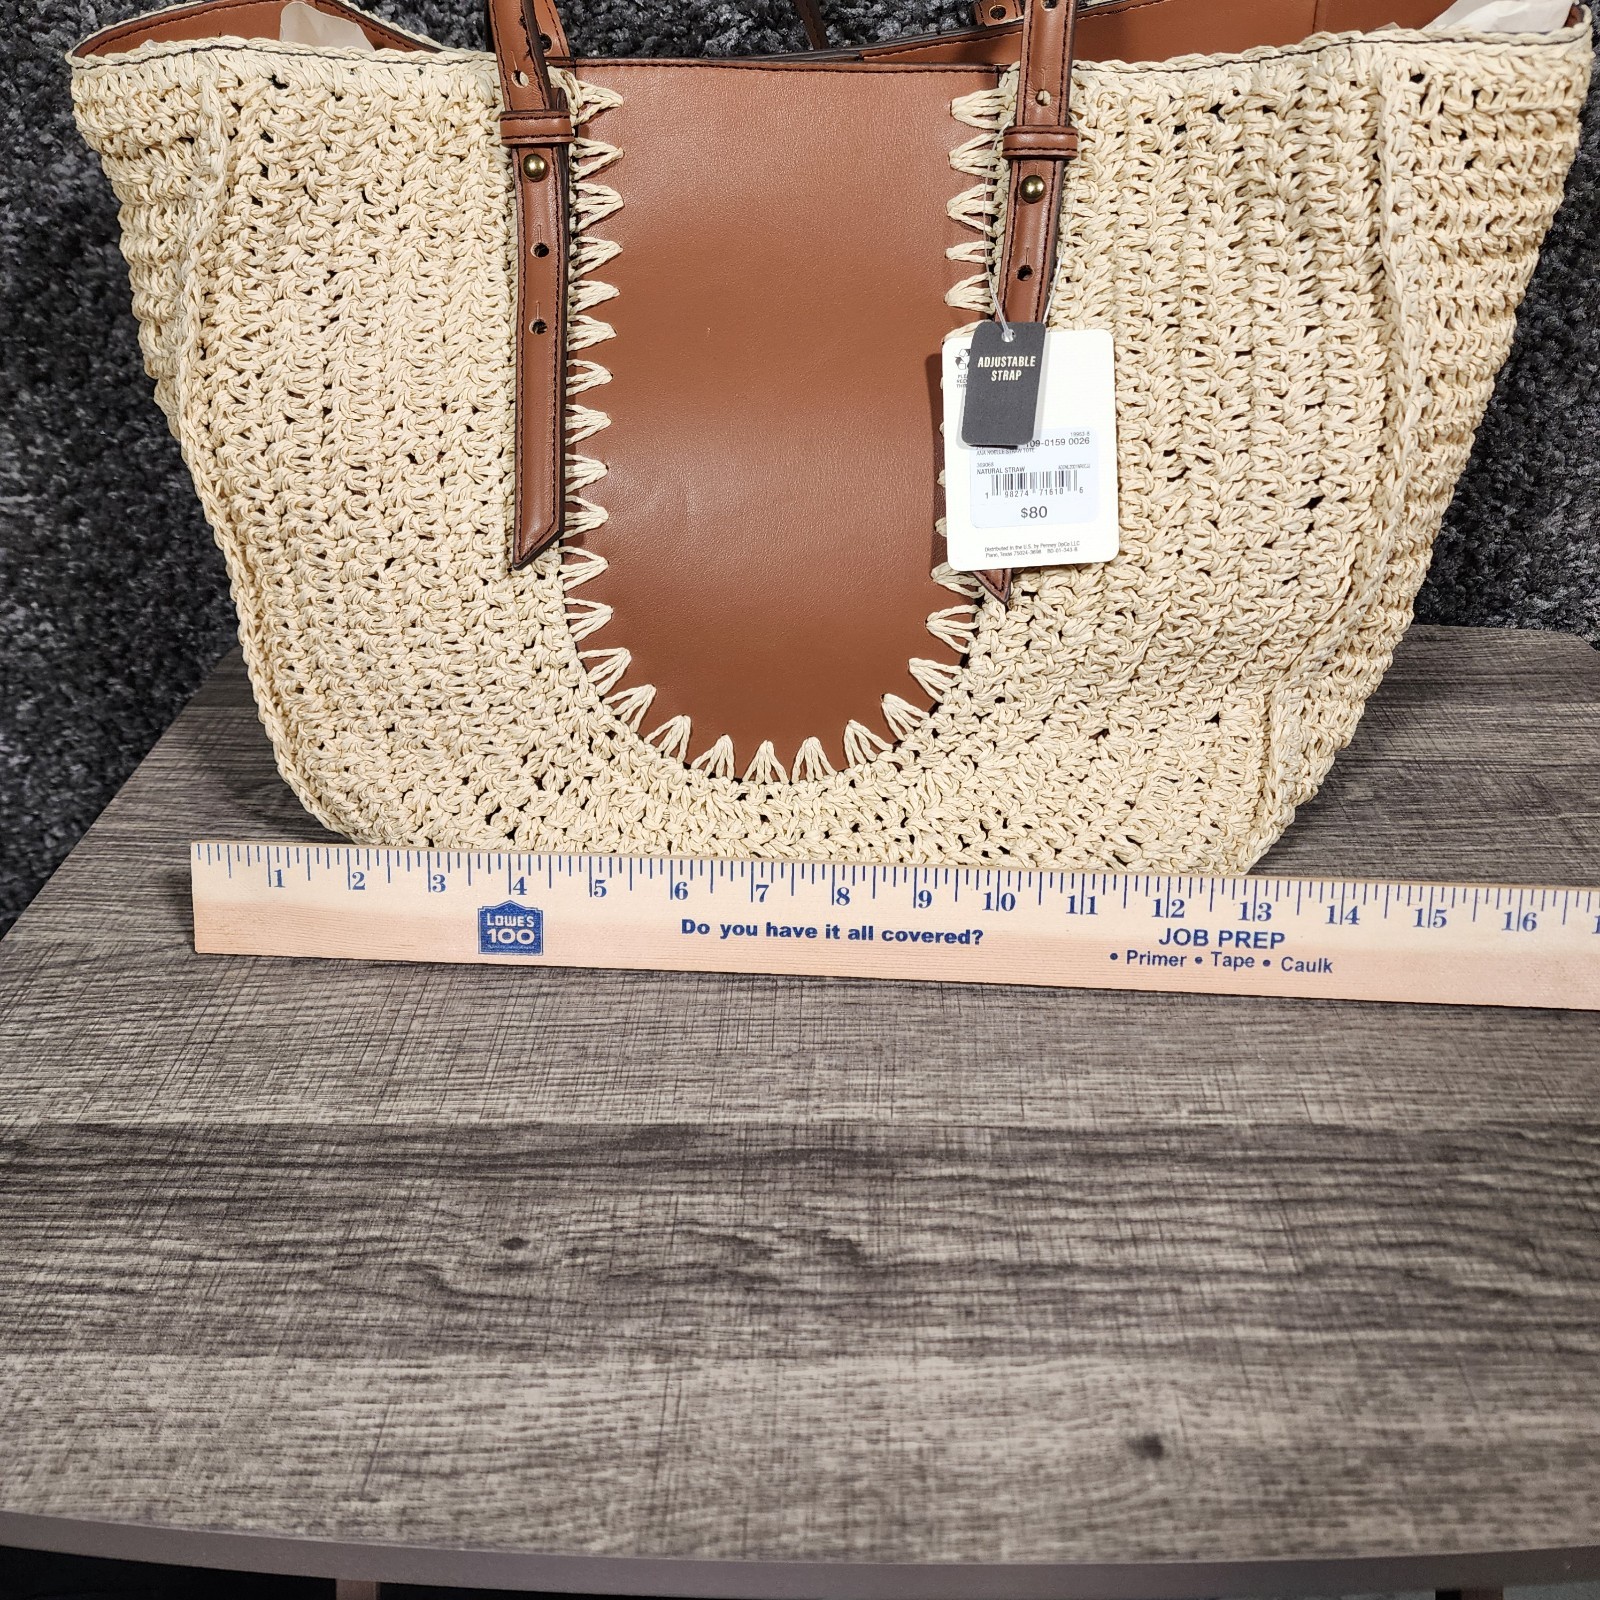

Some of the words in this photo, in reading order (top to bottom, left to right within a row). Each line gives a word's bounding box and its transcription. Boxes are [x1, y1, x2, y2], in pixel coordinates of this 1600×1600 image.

[977, 356, 1036, 368] ADJUSTABLE
[991, 370, 1022, 381] STRAP
[1068, 437, 1090, 446] 0026
[1004, 490, 1029, 498] 98274
[1020, 505, 1048, 519] $80
[273, 869, 286, 888] 1
[352, 871, 366, 891] 2
[432, 874, 446, 893] 3
[512, 876, 528, 896] 4
[593, 879, 607, 898] 5
[674, 881, 688, 901] 6
[755, 884, 769, 903] 7
[836, 886, 850, 906] 8
[918, 889, 933, 909] 9
[982, 891, 1016, 912] 10
[1066, 895, 1099, 915] 11
[1151, 898, 1186, 919] 12
[1237, 902, 1272, 922] 13
[1325, 905, 1360, 925] 14
[1413, 908, 1447, 928] 15
[1501, 911, 1537, 932] 16
[486, 928, 535, 945] 100
[681, 918, 710, 935] Do
[720, 923, 758, 940] you
[766, 922, 818, 939] have
[825, 923, 841, 940] it
[847, 925, 874, 941] all
[881, 928, 984, 945] covered?
[1158, 928, 1209, 947] JOB
[1218, 929, 1286, 950] PREP
[1126, 950, 1187, 968] Primer
[1210, 951, 1255, 971] Tape
[1281, 955, 1333, 974] Caulk
